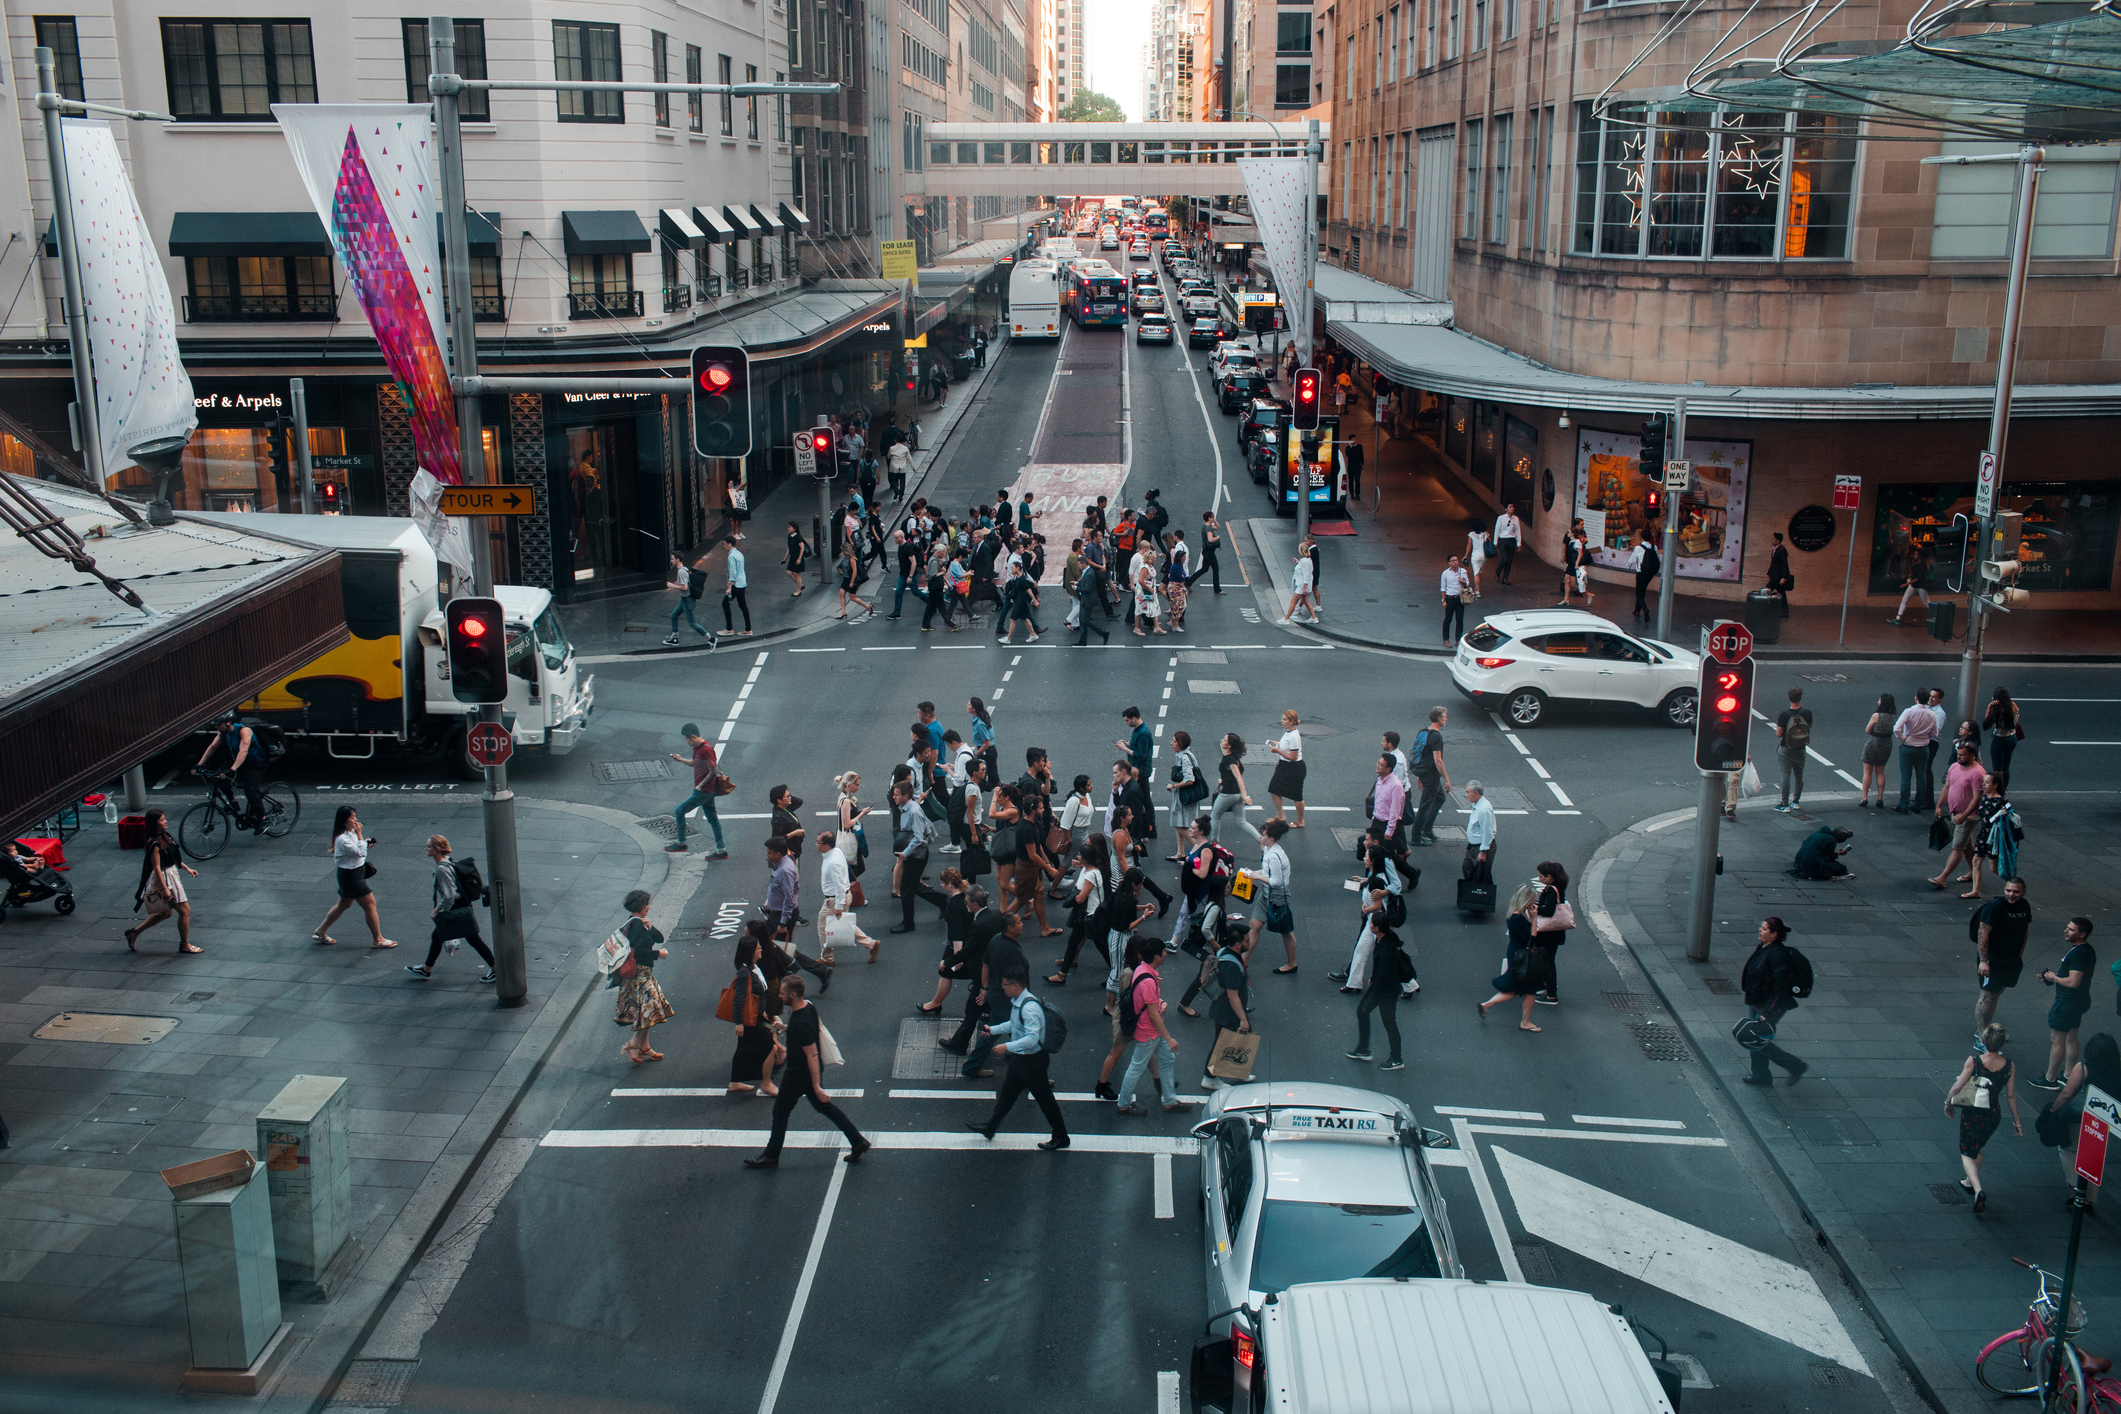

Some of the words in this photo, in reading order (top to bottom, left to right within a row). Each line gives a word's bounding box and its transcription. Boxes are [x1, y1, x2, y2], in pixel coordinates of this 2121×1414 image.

[194, 394, 218, 407] eef
[221, 396, 232, 407] &
[236, 393, 282, 411] Arpels
[564, 393, 583, 402] Van
[1032, 468, 1107, 482] BUS
[1293, 475, 1325, 483] CEK
[1980, 484, 1989, 495] NO
[438, 494, 493, 508] TOUR
[2021, 564, 2040, 572] rket
[2042, 563, 2051, 572] St
[525, 636, 530, 647] St
[1712, 636, 1748, 651] STOP
[472, 736, 508, 752] STOP
[710, 902, 749, 936] LOOK
[1315, 1117, 1354, 1129] TAXI
[1357, 1120, 1377, 1130] RSL
[2092, 1120, 2100, 1129] NO
[2084, 1124, 2105, 1142] STOPPING
